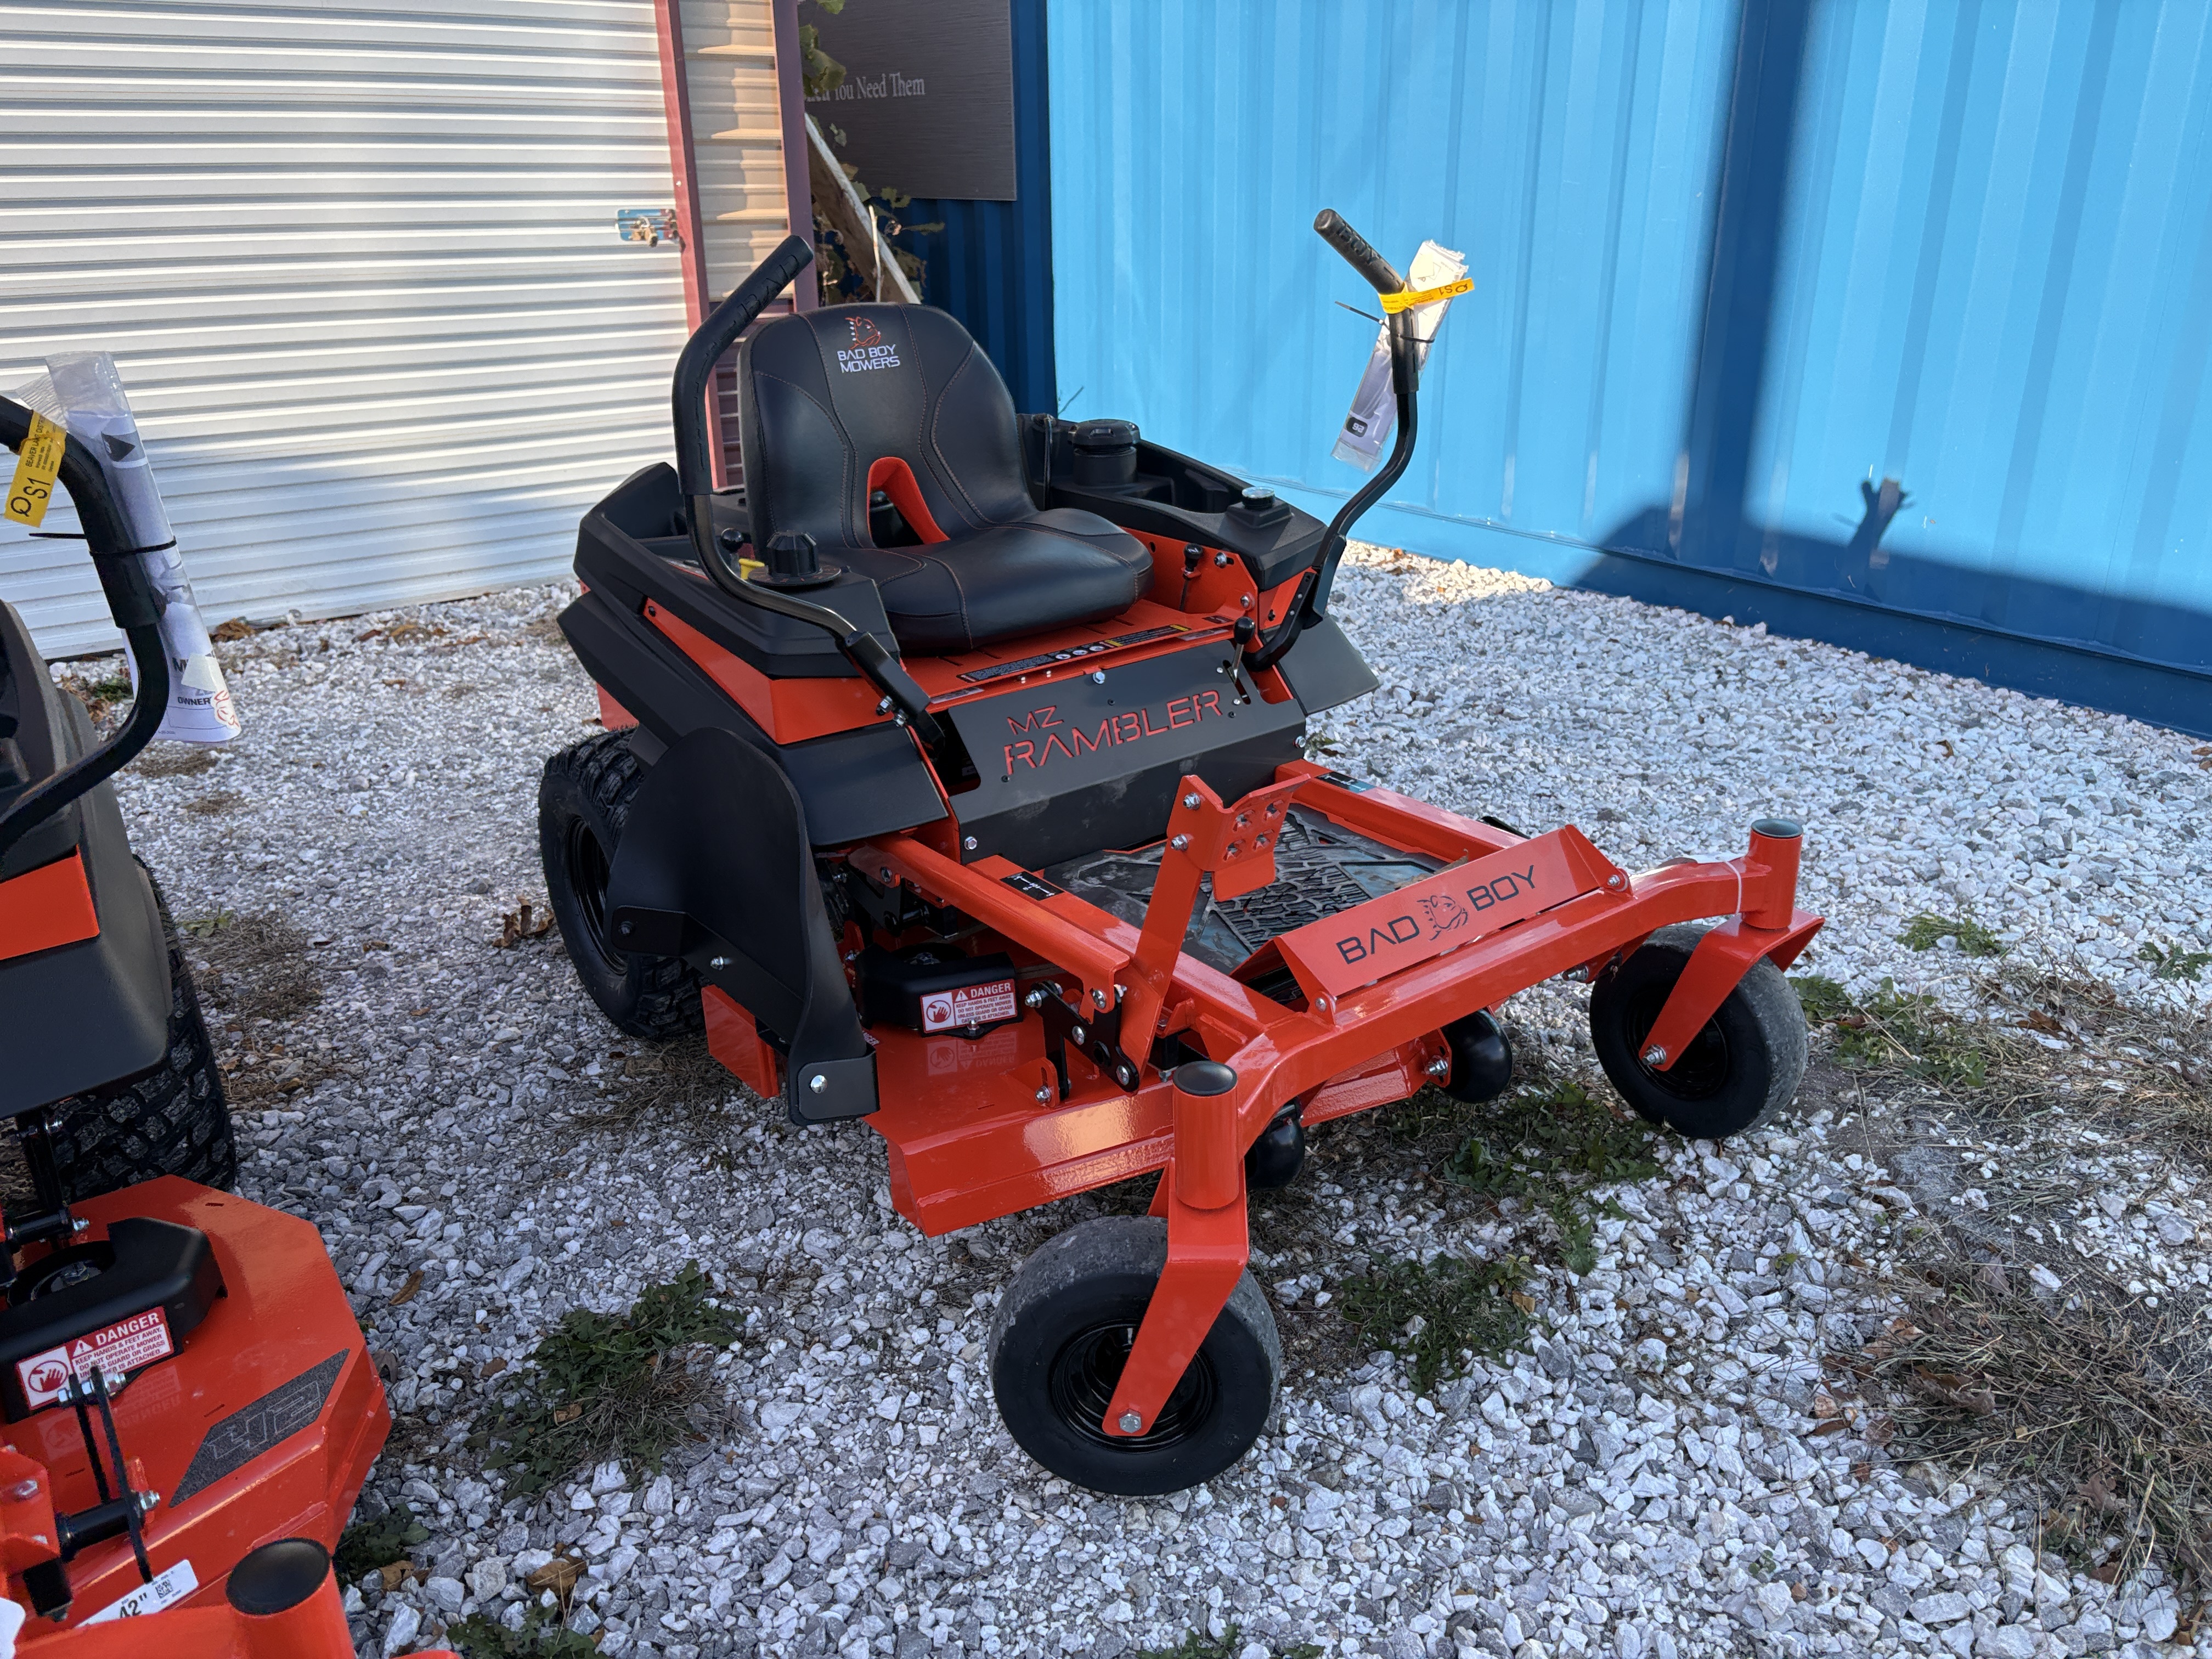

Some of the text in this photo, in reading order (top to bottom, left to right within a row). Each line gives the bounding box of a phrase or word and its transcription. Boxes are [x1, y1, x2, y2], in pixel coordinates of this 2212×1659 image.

[856, 74, 888, 99] Need
[889, 72, 926, 97] Them
[837, 344, 896, 362] BAD BOY
[839, 356, 901, 374] MOWERS
[1003, 690, 1223, 775] RAMBLER
[1006, 705, 1064, 735] MZ
[1336, 865, 1536, 964] BAD BOY
[970, 983, 1011, 998] DANGER
[95, 1312, 160, 1346] DANGER
[75, 1354, 92, 1365] KEEP
[94, 1345, 117, 1358] HANDS
[125, 1335, 141, 1345] FEET
[80, 1362, 89, 1371] DO
[91, 1356, 104, 1365] NOT
[105, 1346, 136, 1361] OPERATE
[137, 1334, 162, 1347] MOWER
[108, 1354, 131, 1368] GUARD
[132, 1349, 142, 1357] OR
[143, 1340, 165, 1353] GRASS
[119, 1362, 126, 1370] IS
